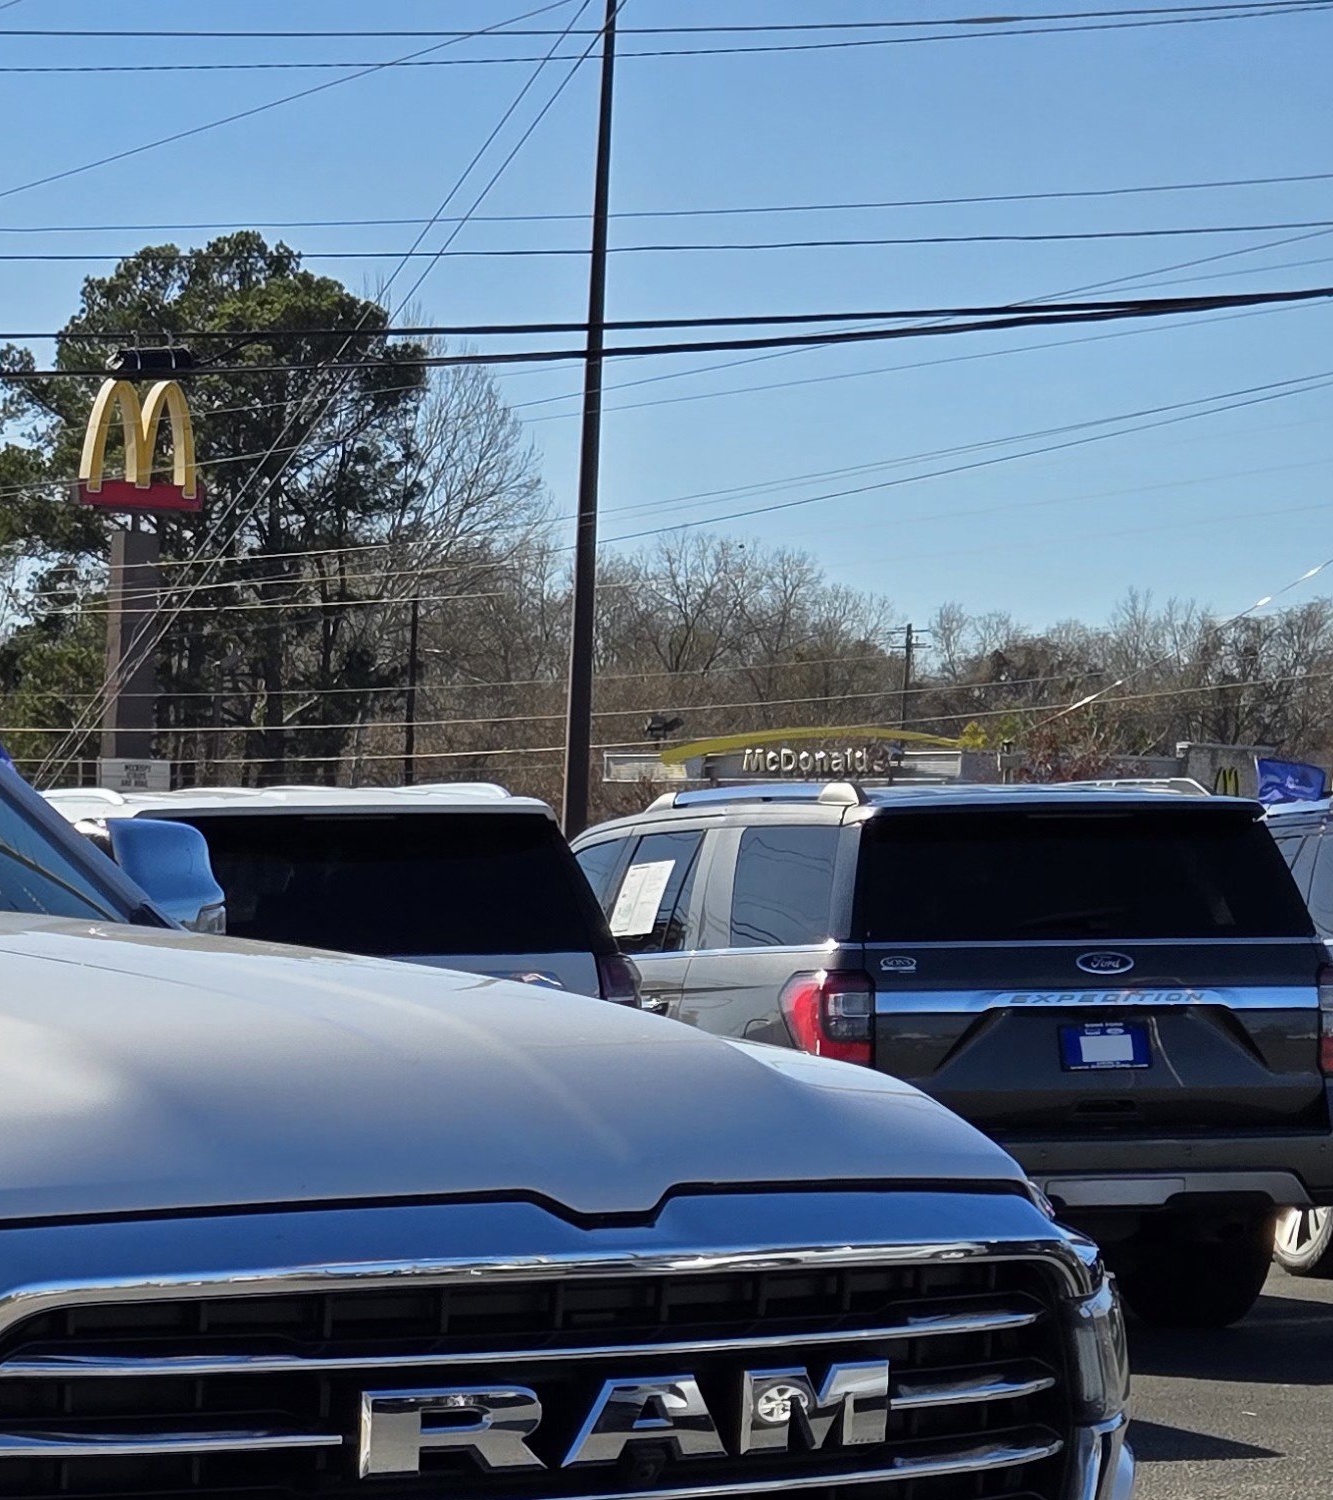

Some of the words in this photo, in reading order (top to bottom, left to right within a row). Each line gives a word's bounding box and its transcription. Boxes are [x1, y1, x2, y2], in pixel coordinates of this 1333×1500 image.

[1090, 954, 1120, 969] Ford
[1009, 992, 1206, 1004] EXPEDITION
[359, 1360, 889, 1479] RAM
